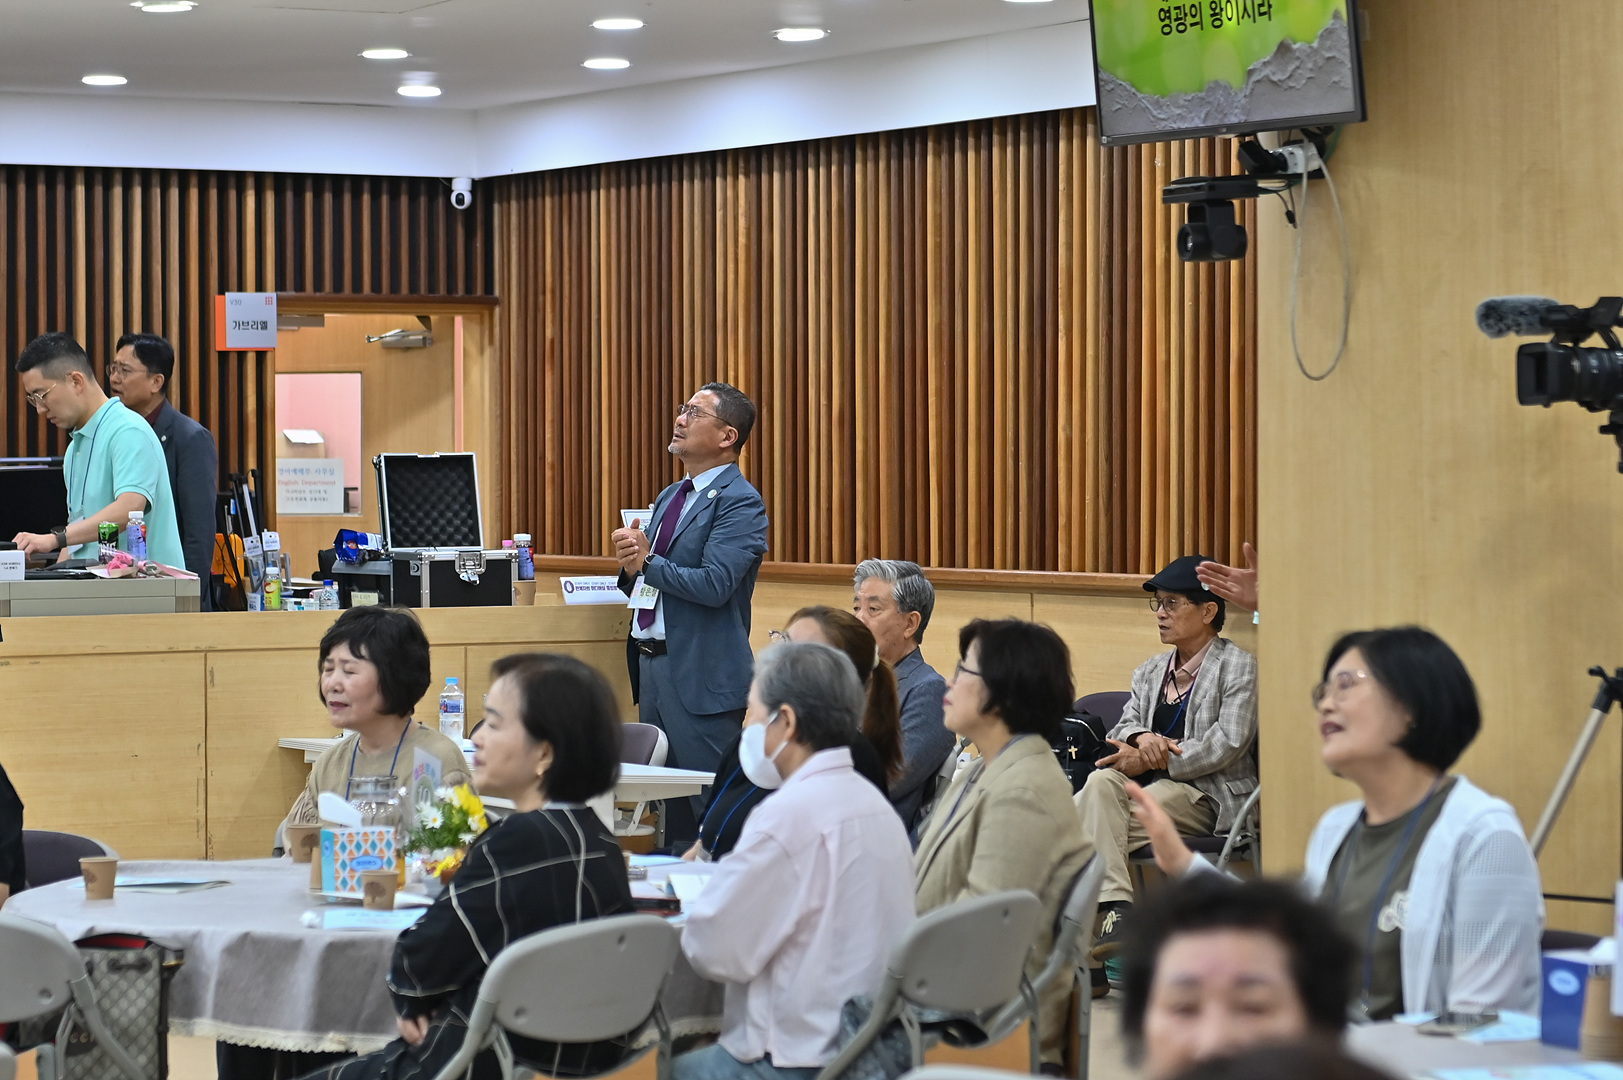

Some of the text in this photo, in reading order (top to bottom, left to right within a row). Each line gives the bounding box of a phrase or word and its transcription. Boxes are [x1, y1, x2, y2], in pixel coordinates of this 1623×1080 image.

[1158, 0, 1273, 36] 영광의 왕이시라
[229, 298, 242, 306] V30
[232, 320, 268, 331] 가브리엘
[315, 467, 335, 476] 사무실
[278, 479, 336, 487] English Department
